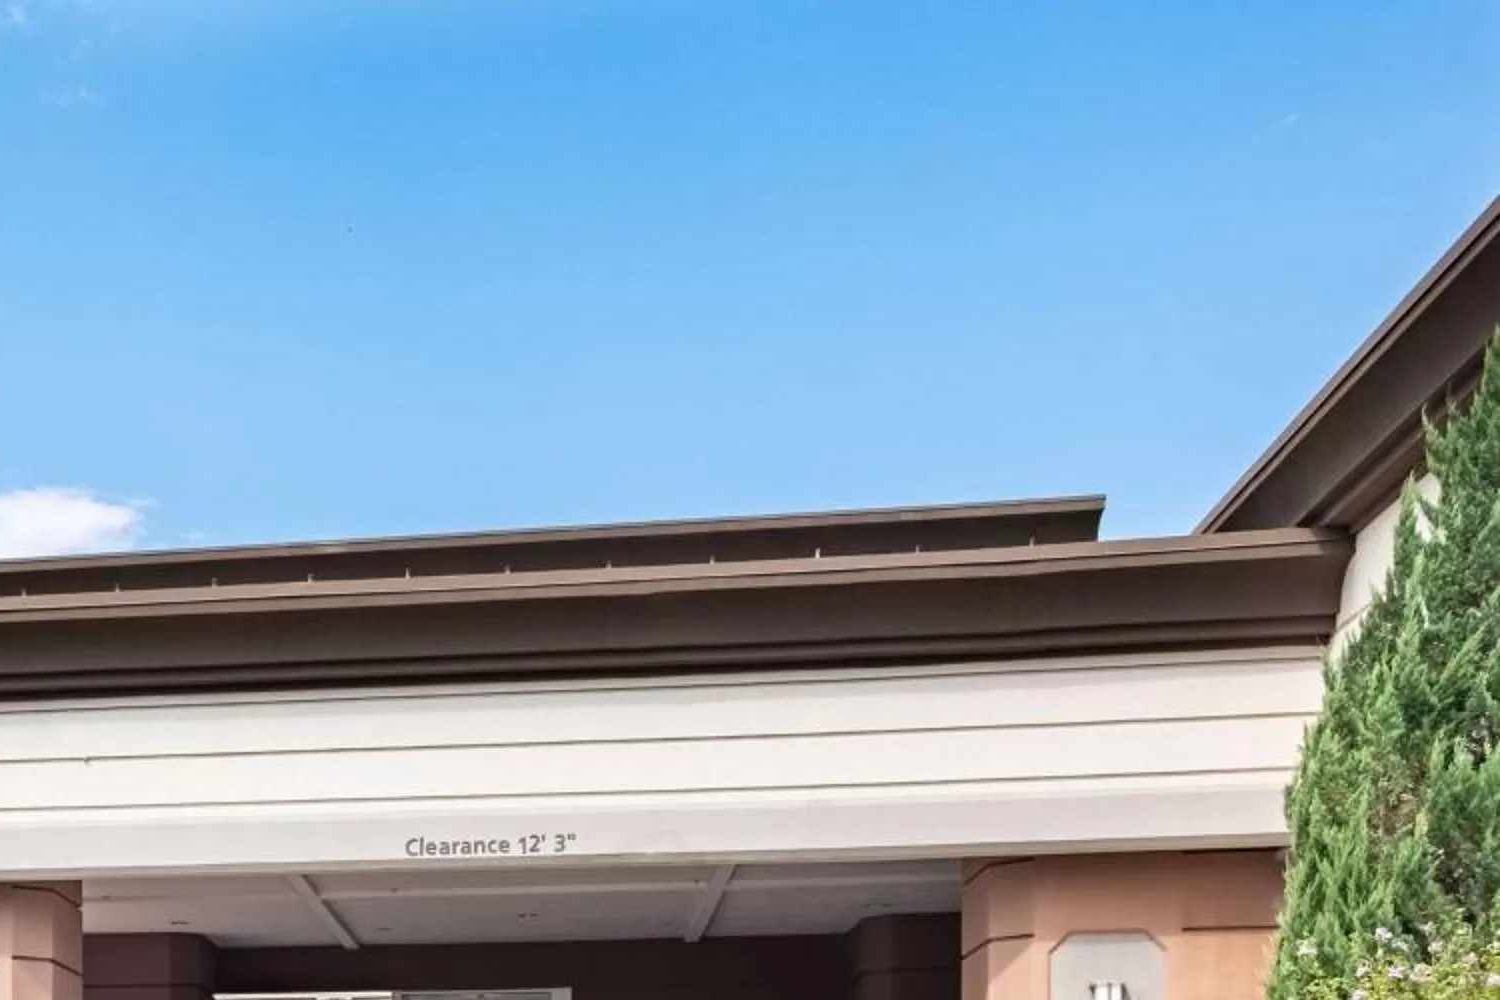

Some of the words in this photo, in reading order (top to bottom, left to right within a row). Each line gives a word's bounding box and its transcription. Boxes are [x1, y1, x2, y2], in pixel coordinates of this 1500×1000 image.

[405, 836, 511, 857] Clearance
[517, 833, 547, 854] 12'
[553, 832, 577, 853] 3"
